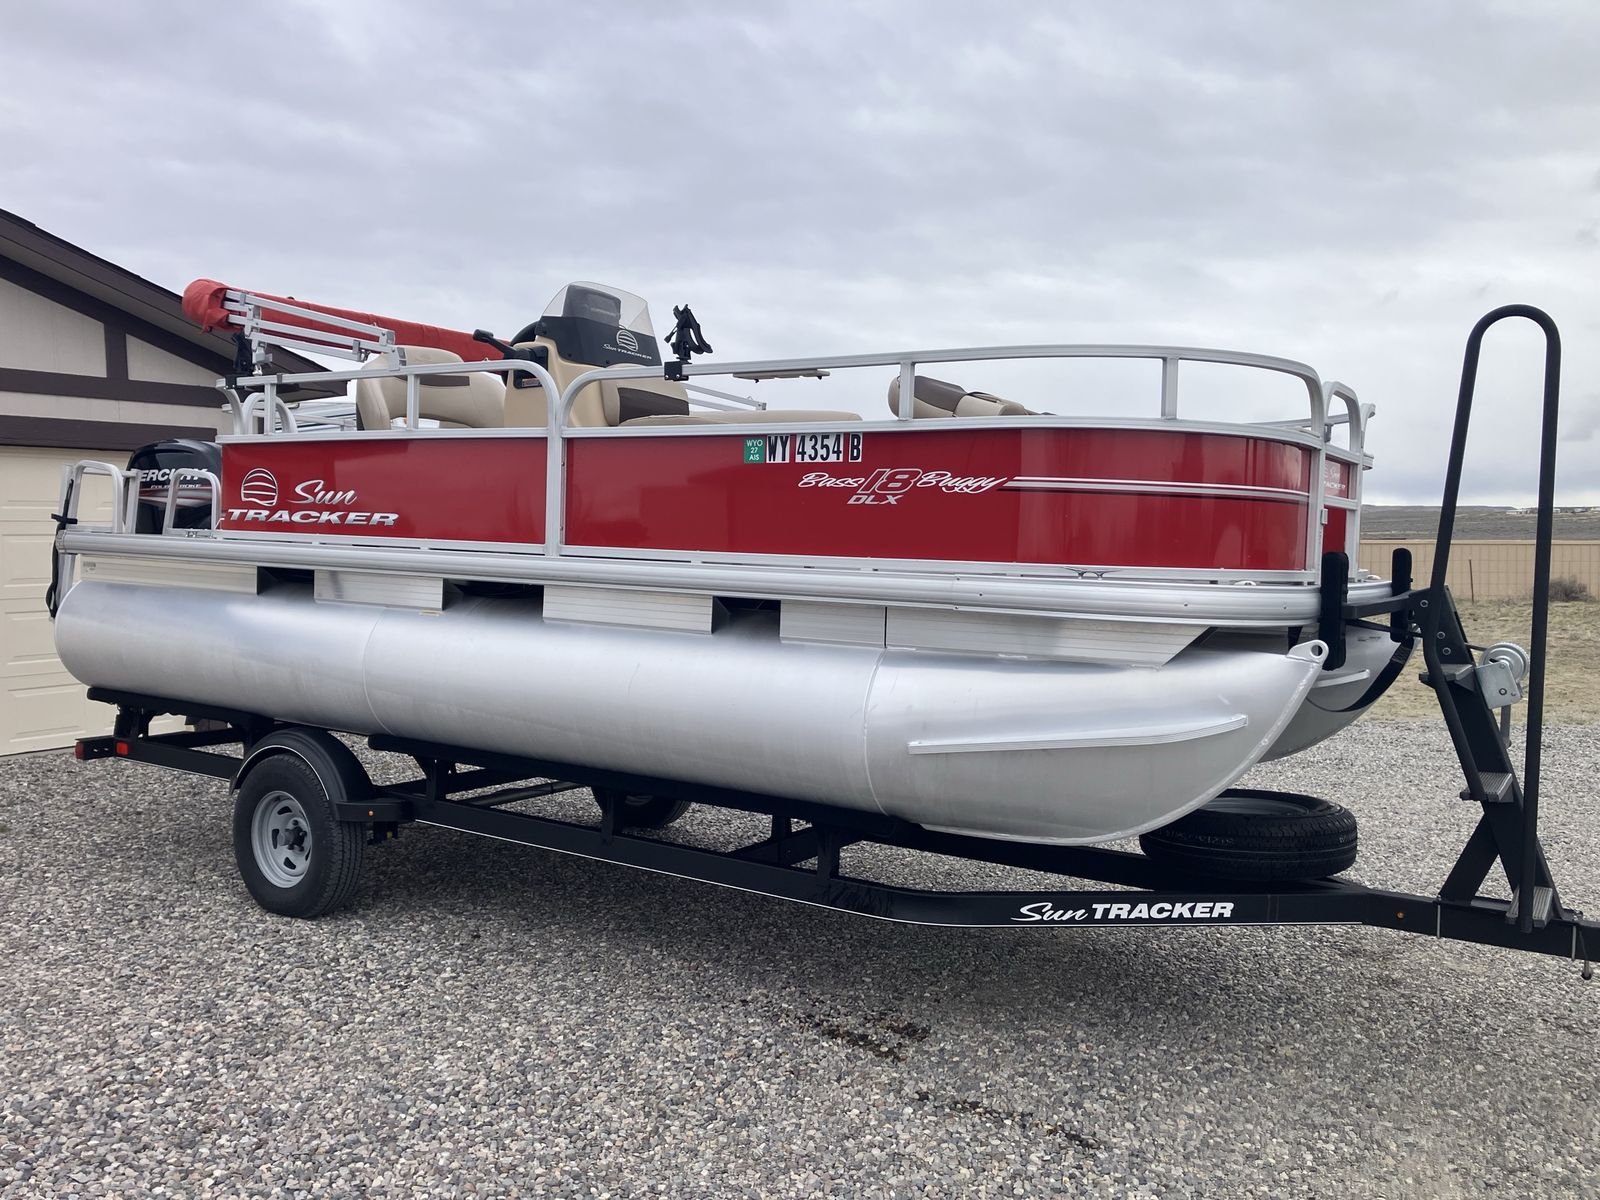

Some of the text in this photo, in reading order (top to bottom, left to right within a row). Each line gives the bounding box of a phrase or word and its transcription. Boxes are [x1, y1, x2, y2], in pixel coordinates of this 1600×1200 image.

[746, 439, 763, 447] WYO
[767, 433, 861, 462] WY 4354 B
[798, 468, 1007, 494] Bass 18 Buggy
[287, 479, 358, 505] Sun
[846, 495, 904, 505] DLX
[228, 508, 399, 526] TRACKER
[1010, 902, 1235, 922] Sun TRACKER
